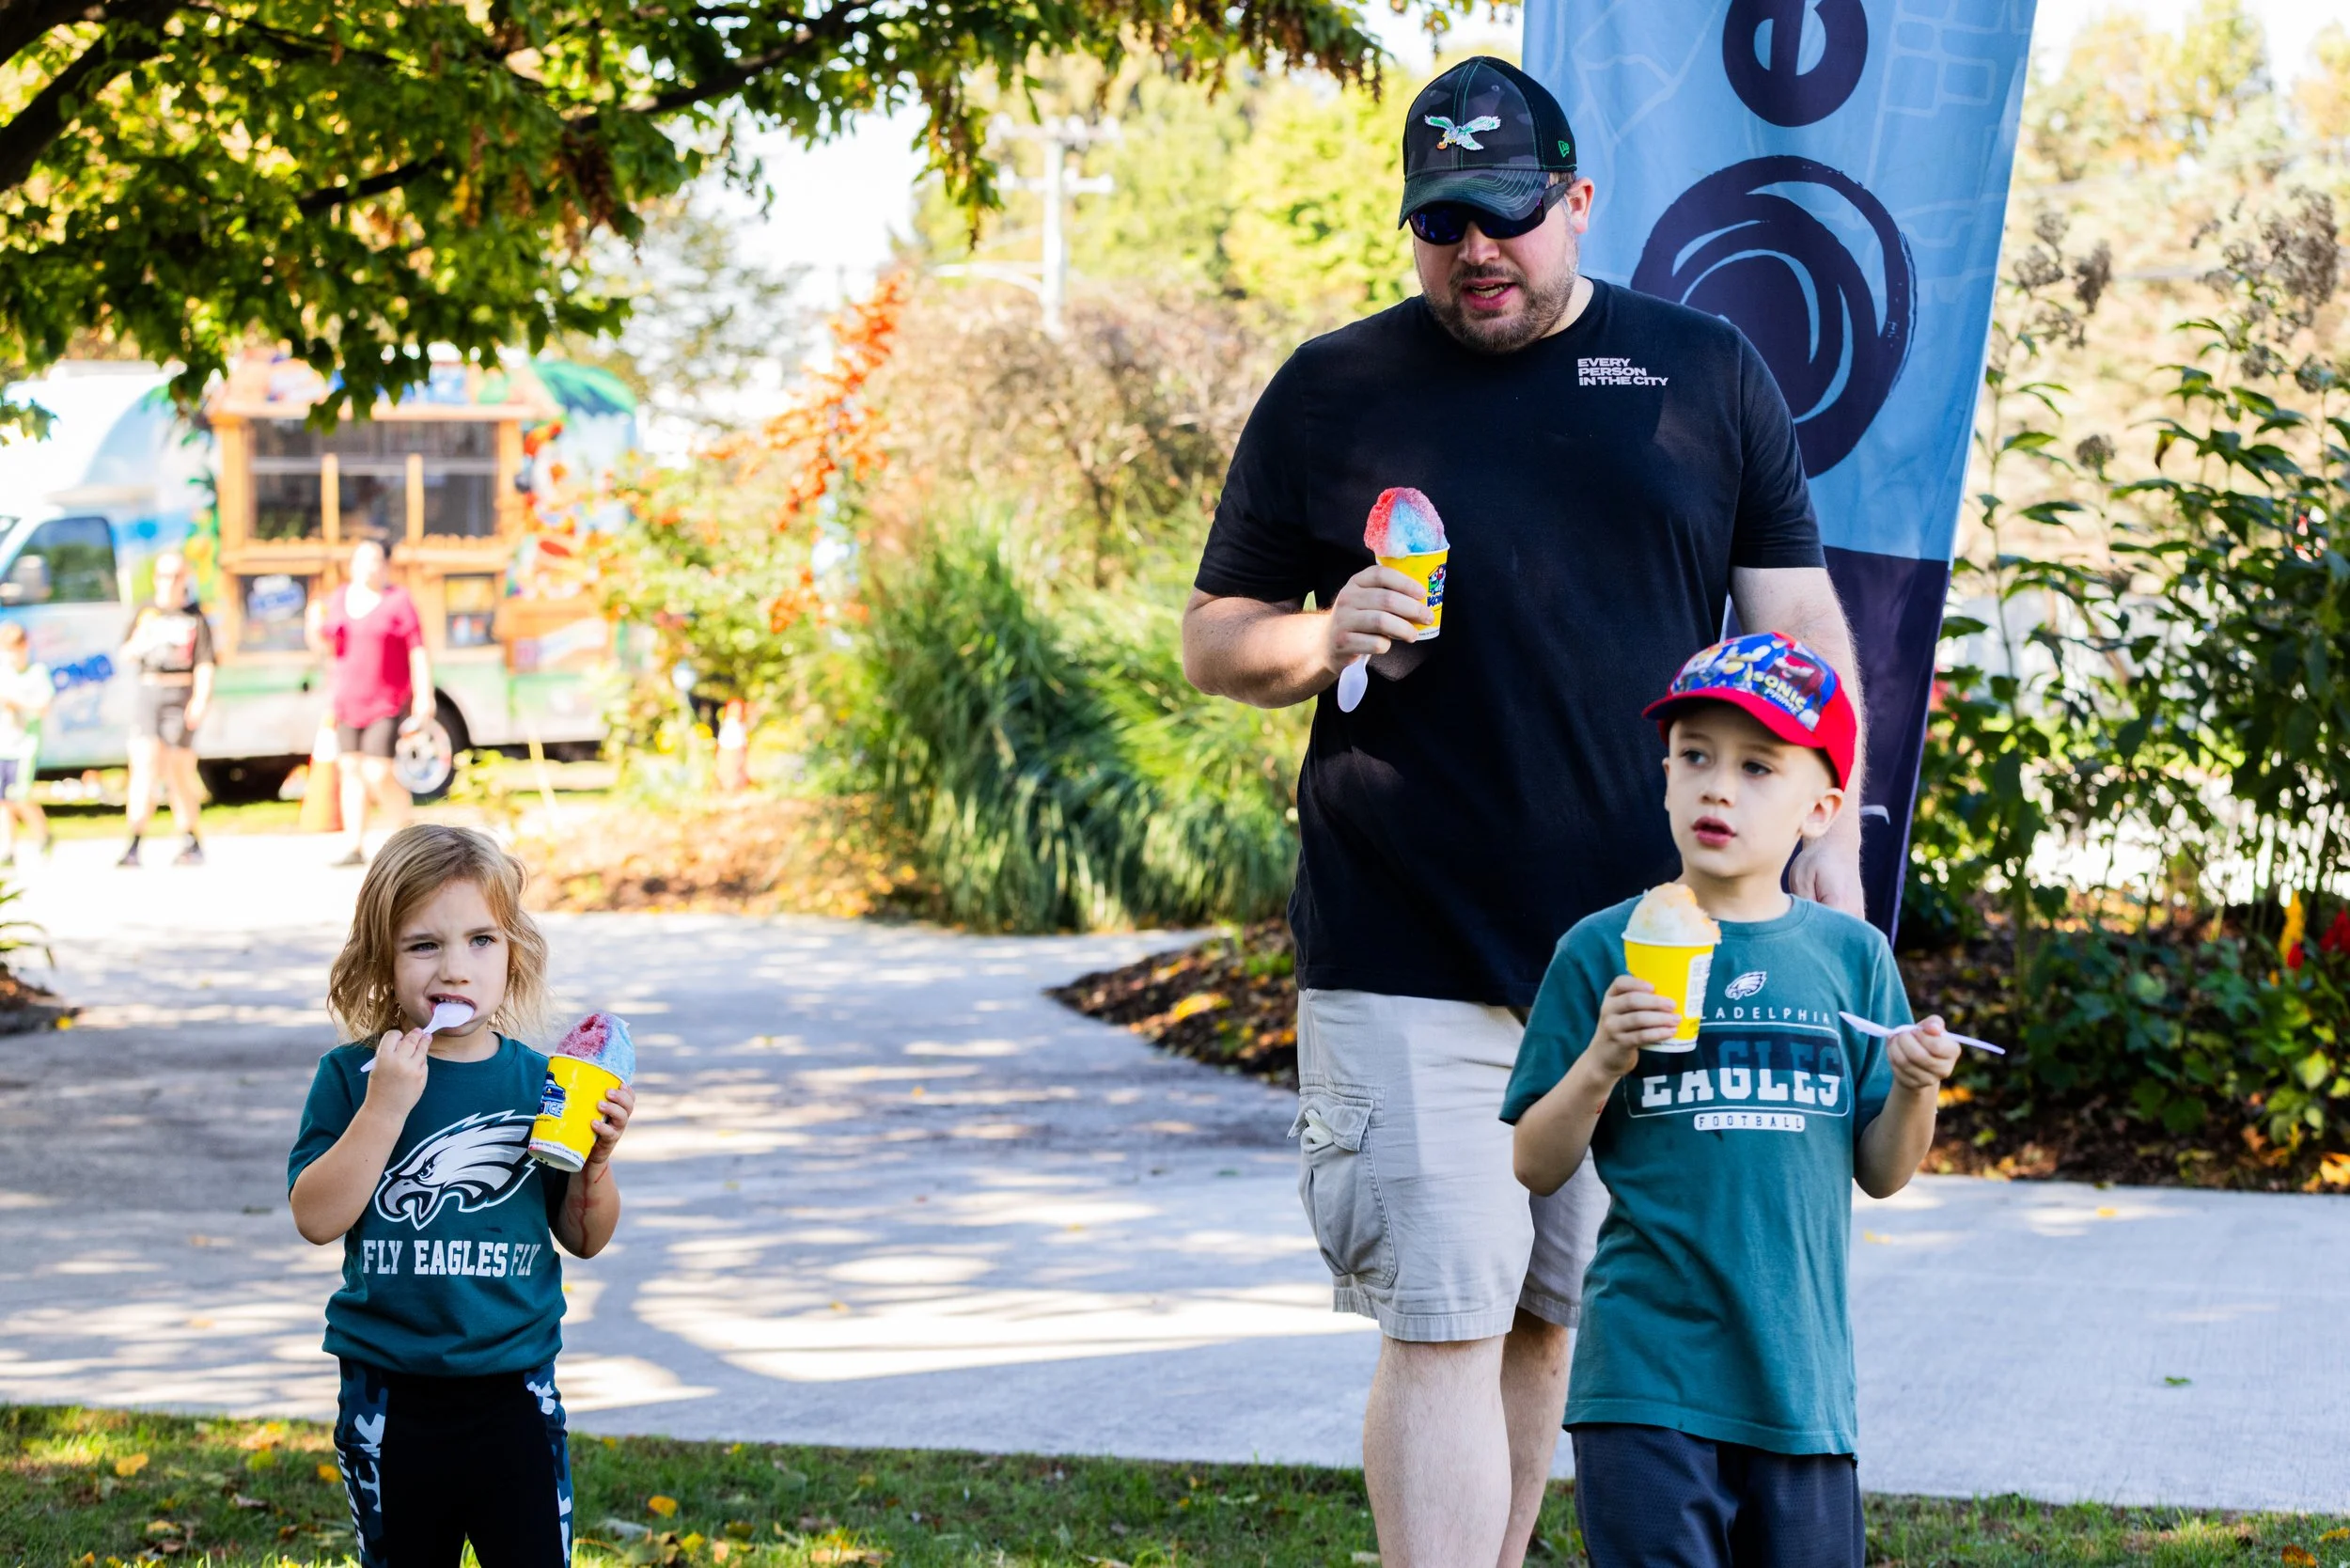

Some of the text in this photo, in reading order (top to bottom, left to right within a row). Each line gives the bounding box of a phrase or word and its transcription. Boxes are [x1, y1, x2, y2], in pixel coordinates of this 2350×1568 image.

[1577, 358, 1630, 368] EVERY
[1578, 368, 1647, 376] PERSON
[1579, 377, 1668, 385] IN THE CITY
[1427, 594, 1443, 607] KON
[1753, 671, 1807, 712] SONIC
[1700, 1007, 1831, 1024] ADELPHIA
[1641, 1040, 1841, 1108] EAGLES
[544, 1100, 565, 1118] ICE
[1699, 1115, 1802, 1129] FOOTBALL
[363, 1239, 540, 1278] FLY EAGLES FLY
